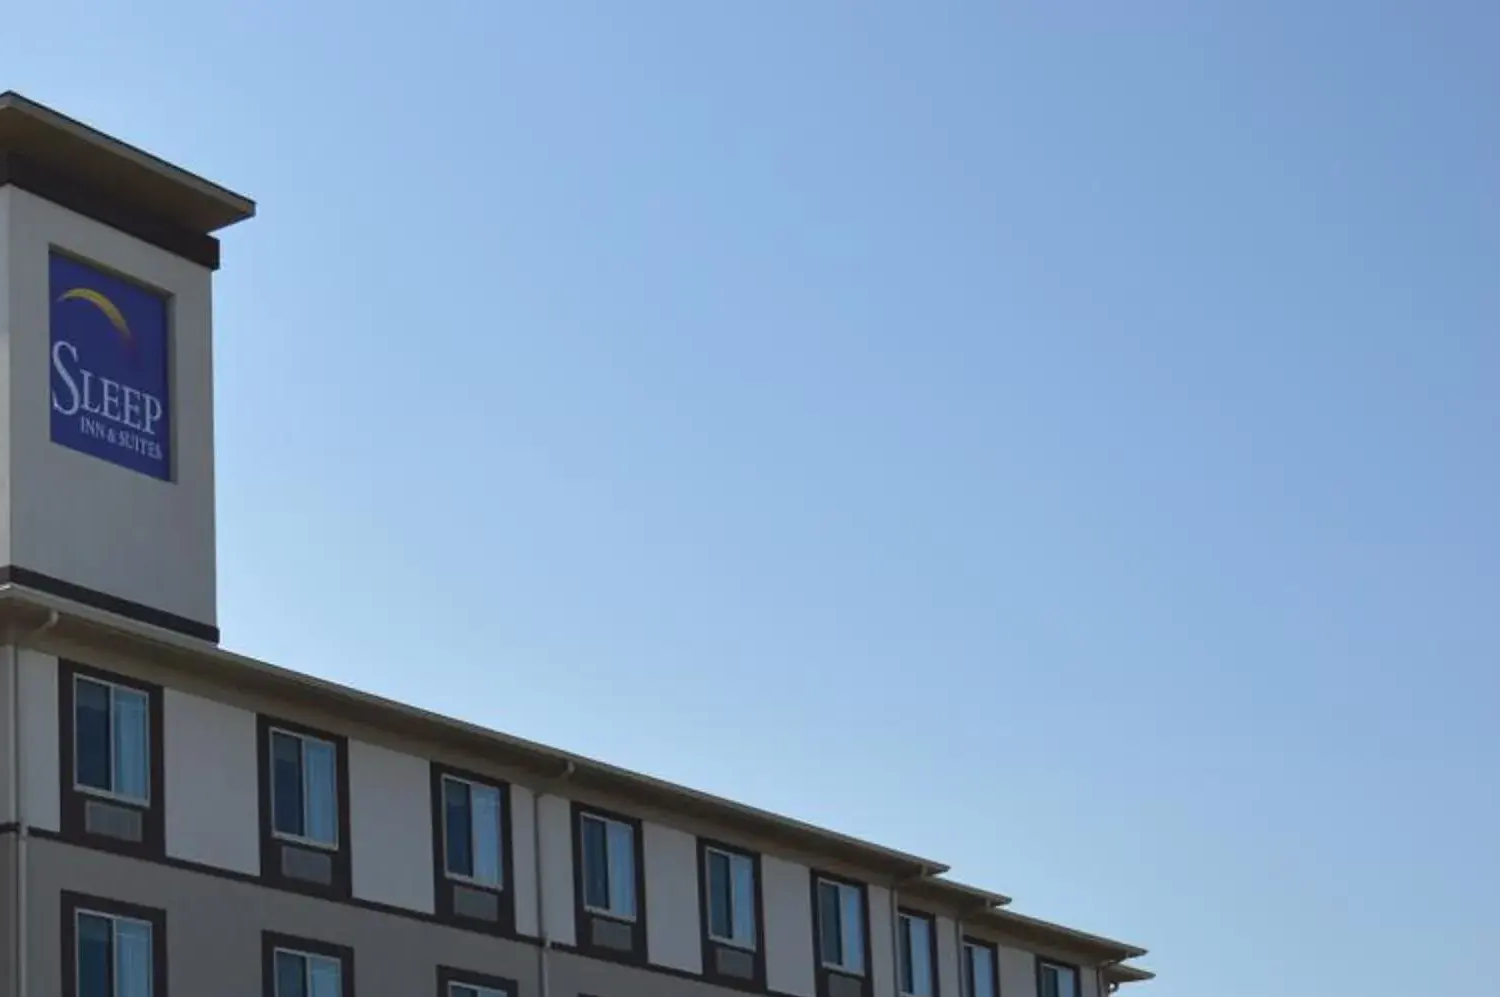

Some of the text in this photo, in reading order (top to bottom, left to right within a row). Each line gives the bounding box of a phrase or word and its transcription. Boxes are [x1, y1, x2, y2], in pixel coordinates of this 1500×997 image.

[51, 340, 163, 435] SLEEP
[80, 415, 163, 461] INN & SUITES
